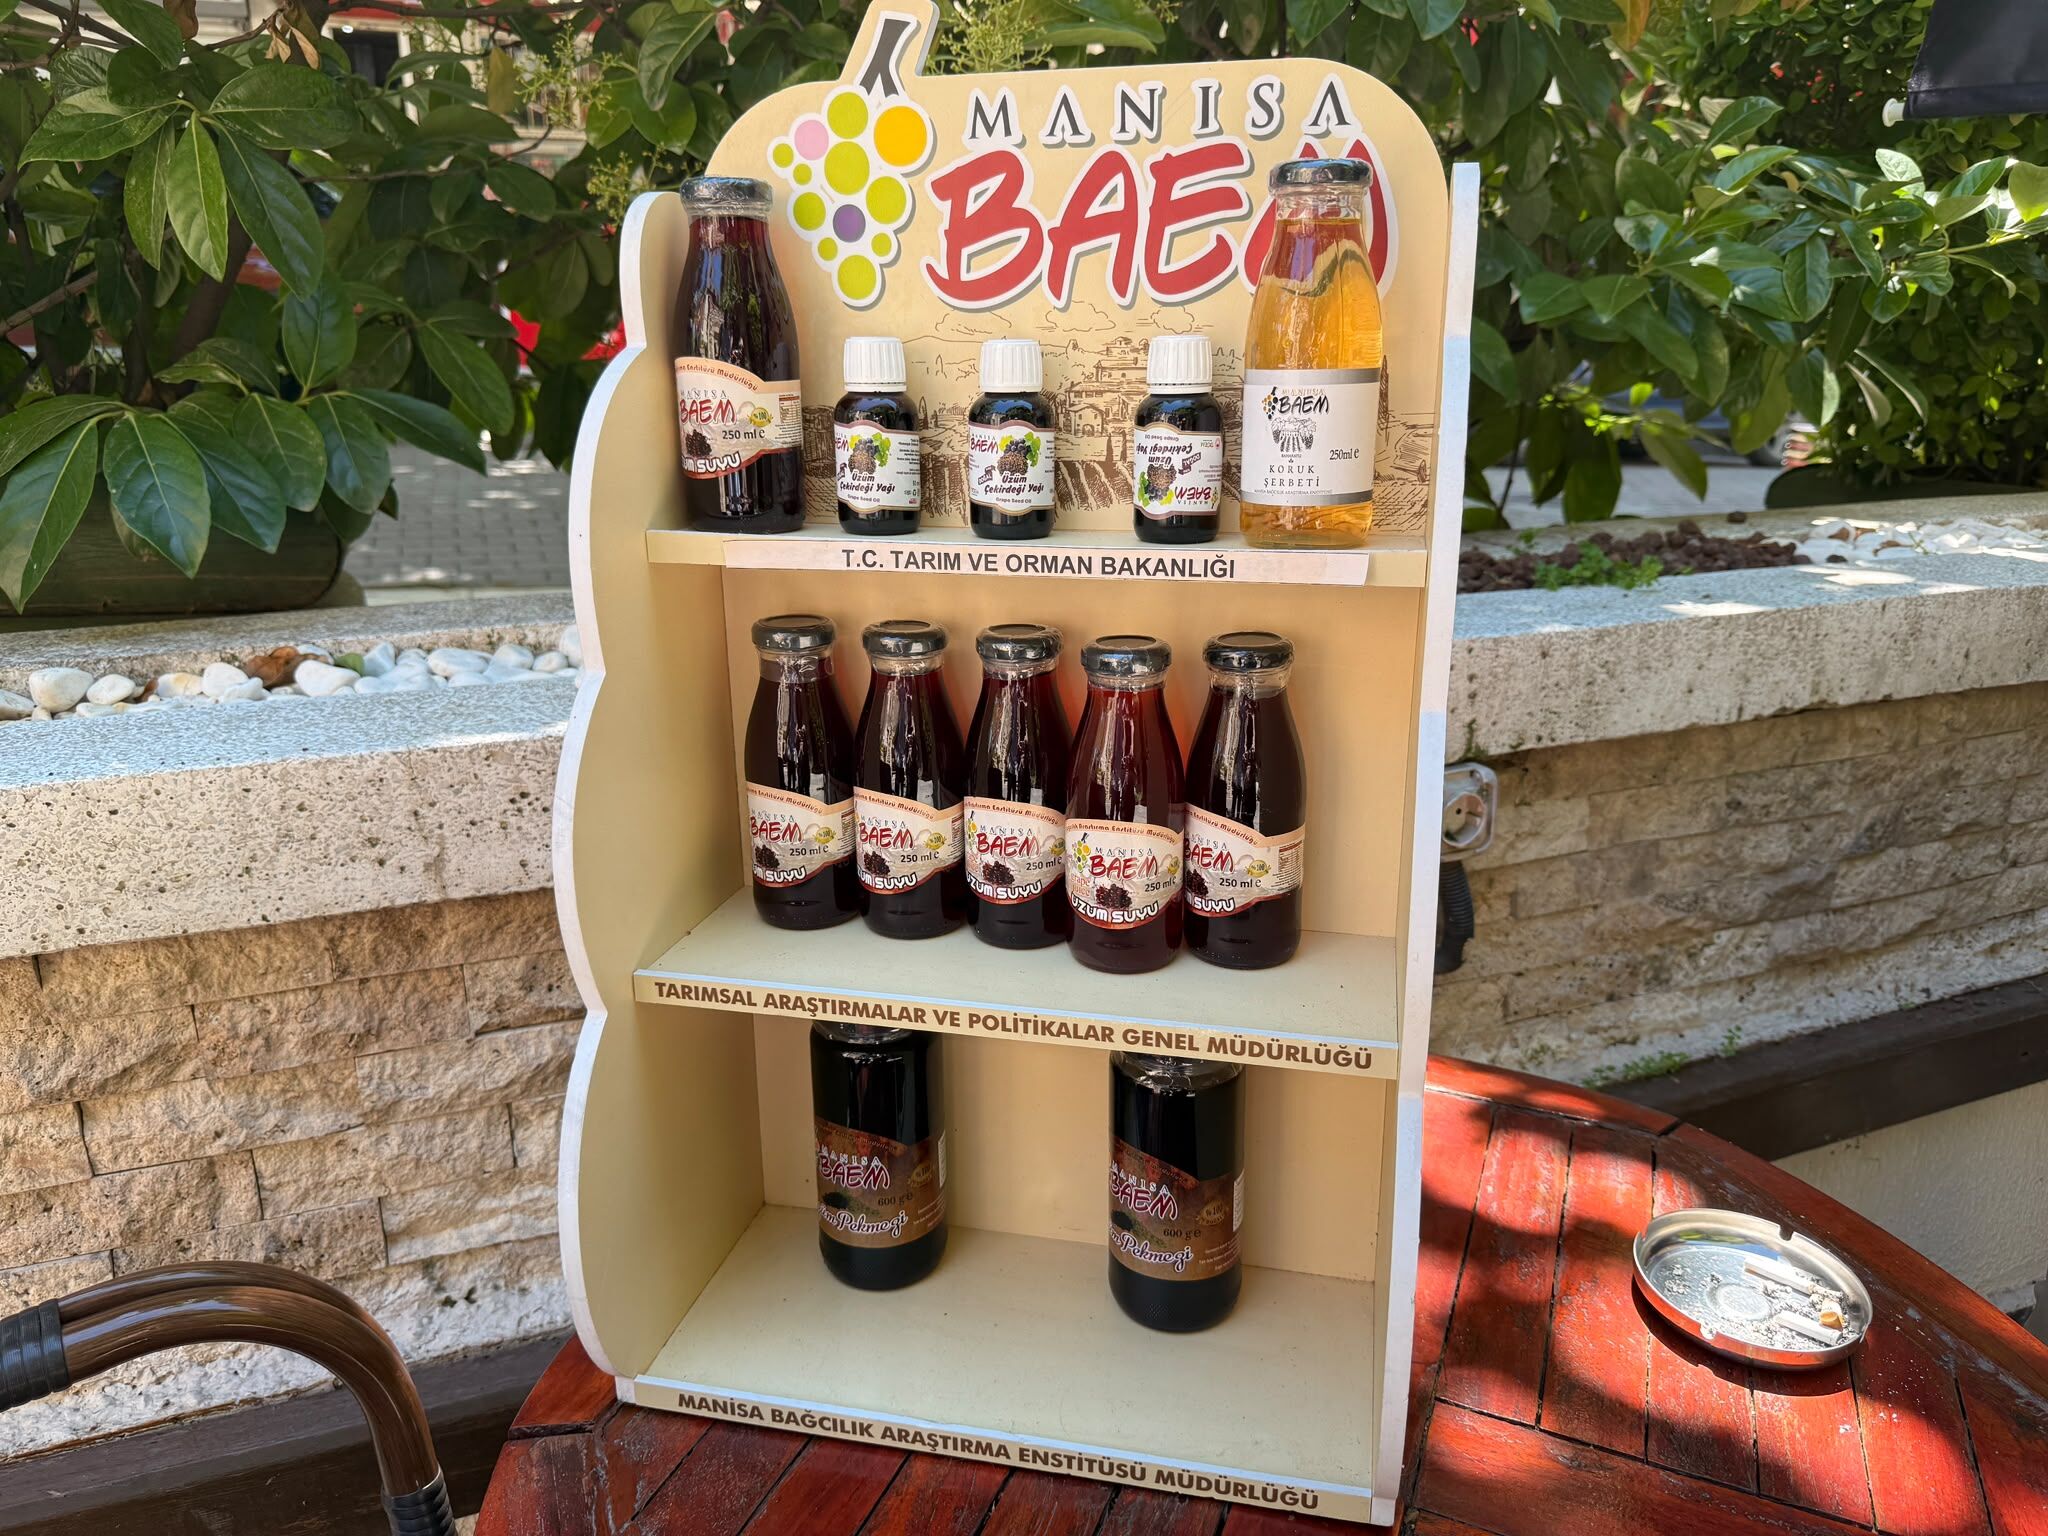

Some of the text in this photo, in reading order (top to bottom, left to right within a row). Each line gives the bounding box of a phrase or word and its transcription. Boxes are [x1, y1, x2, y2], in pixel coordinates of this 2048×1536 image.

[968, 80, 1352, 141] MANISA
[1278, 395, 1329, 414] BAEM
[722, 430, 741, 440] 250
[743, 429, 757, 440] ml
[970, 437, 998, 455] BAEM
[1149, 442, 1193, 455] Çekirdeği
[1329, 447, 1353, 460] 250ml
[697, 450, 741, 473] SUYU
[1148, 455, 1172, 468] Üzüm
[1269, 464, 1315, 474] KORUK
[851, 470, 875, 482] Üzüm
[1001, 470, 1027, 483] Üzüm
[1263, 475, 1320, 488] ŞERBETİ
[840, 481, 873, 494] Çekirdeği
[876, 483, 896, 495] Yağı
[984, 484, 1026, 496] Çekirdeği
[1027, 483, 1044, 495] Yağı
[1174, 486, 1212, 500] BAEM
[841, 549, 1235, 579] T.C. TARIM VE ORMAN BAKANLIĞI
[750, 816, 803, 843] BAEM
[859, 822, 914, 849] BAEM
[789, 847, 807, 857] 250
[809, 844, 821, 855] ml
[976, 832, 1040, 857] BAEM
[900, 854, 918, 863] 250
[920, 851, 932, 862] ml
[1025, 861, 1044, 871] 250
[1045, 859, 1057, 868] ml
[765, 865, 807, 883] SUYU
[1089, 854, 1158, 879] BAEM
[874, 871, 918, 890] SUYU
[1144, 882, 1161, 893] 250
[1162, 878, 1172, 889] ml
[1219, 877, 1238, 888] 250
[1240, 878, 1253, 888] ml
[996, 879, 1042, 900] SUYU
[1111, 900, 1159, 924] SUYU
[1194, 896, 1236, 913] SUYU
[654, 981, 1373, 1070] TARIMSAL ARAŞTIRMALAR VE POLİTİKALAR GENEL MÜDÜRLÜĞÜ
[819, 1155, 890, 1191] BAEM
[1110, 1170, 1179, 1221] BAEM
[1163, 1227, 1183, 1238] 600
[677, 1393, 1320, 1510] MANİSA BAĞCILIK ARAŞTIRMA ENSTİTÜSÜ MÜDÜRLÜĞÜ
